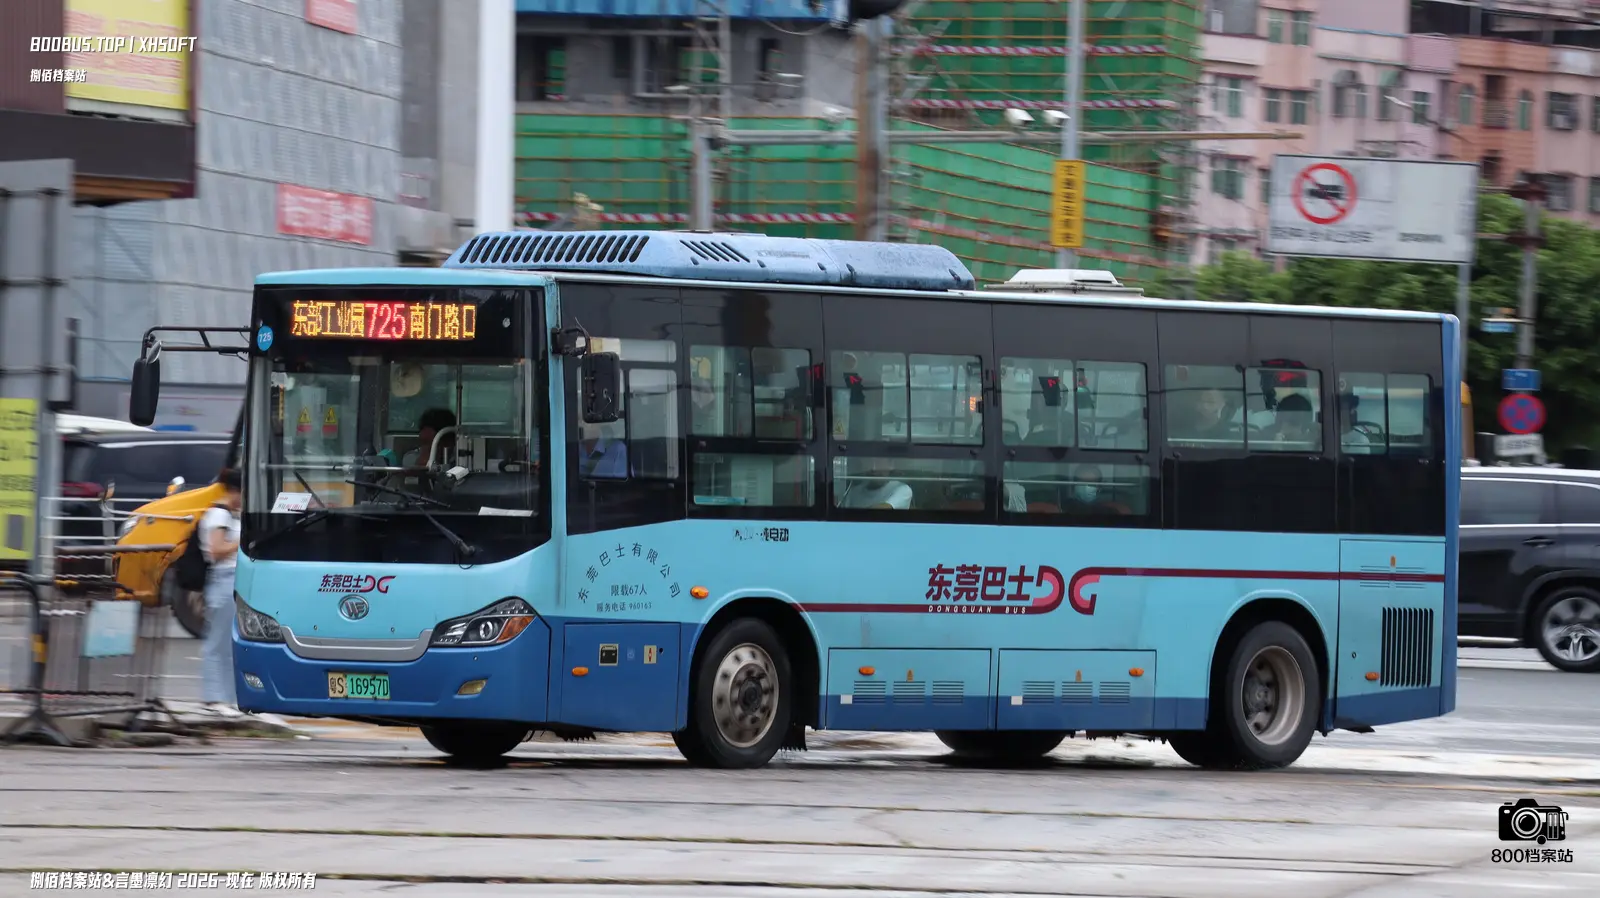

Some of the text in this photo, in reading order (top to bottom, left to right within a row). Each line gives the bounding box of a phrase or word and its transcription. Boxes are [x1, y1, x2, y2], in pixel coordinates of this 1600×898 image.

[365, 302, 406, 339] 725
[409, 302, 476, 340] 南门路口
[320, 574, 363, 588] 东莞巴士
[925, 563, 1034, 602] 东莞巴士
[610, 583, 648, 597] 限载67人
[596, 601, 626, 613] 服务电话
[928, 605, 1026, 614] DONGGUAN BUS
